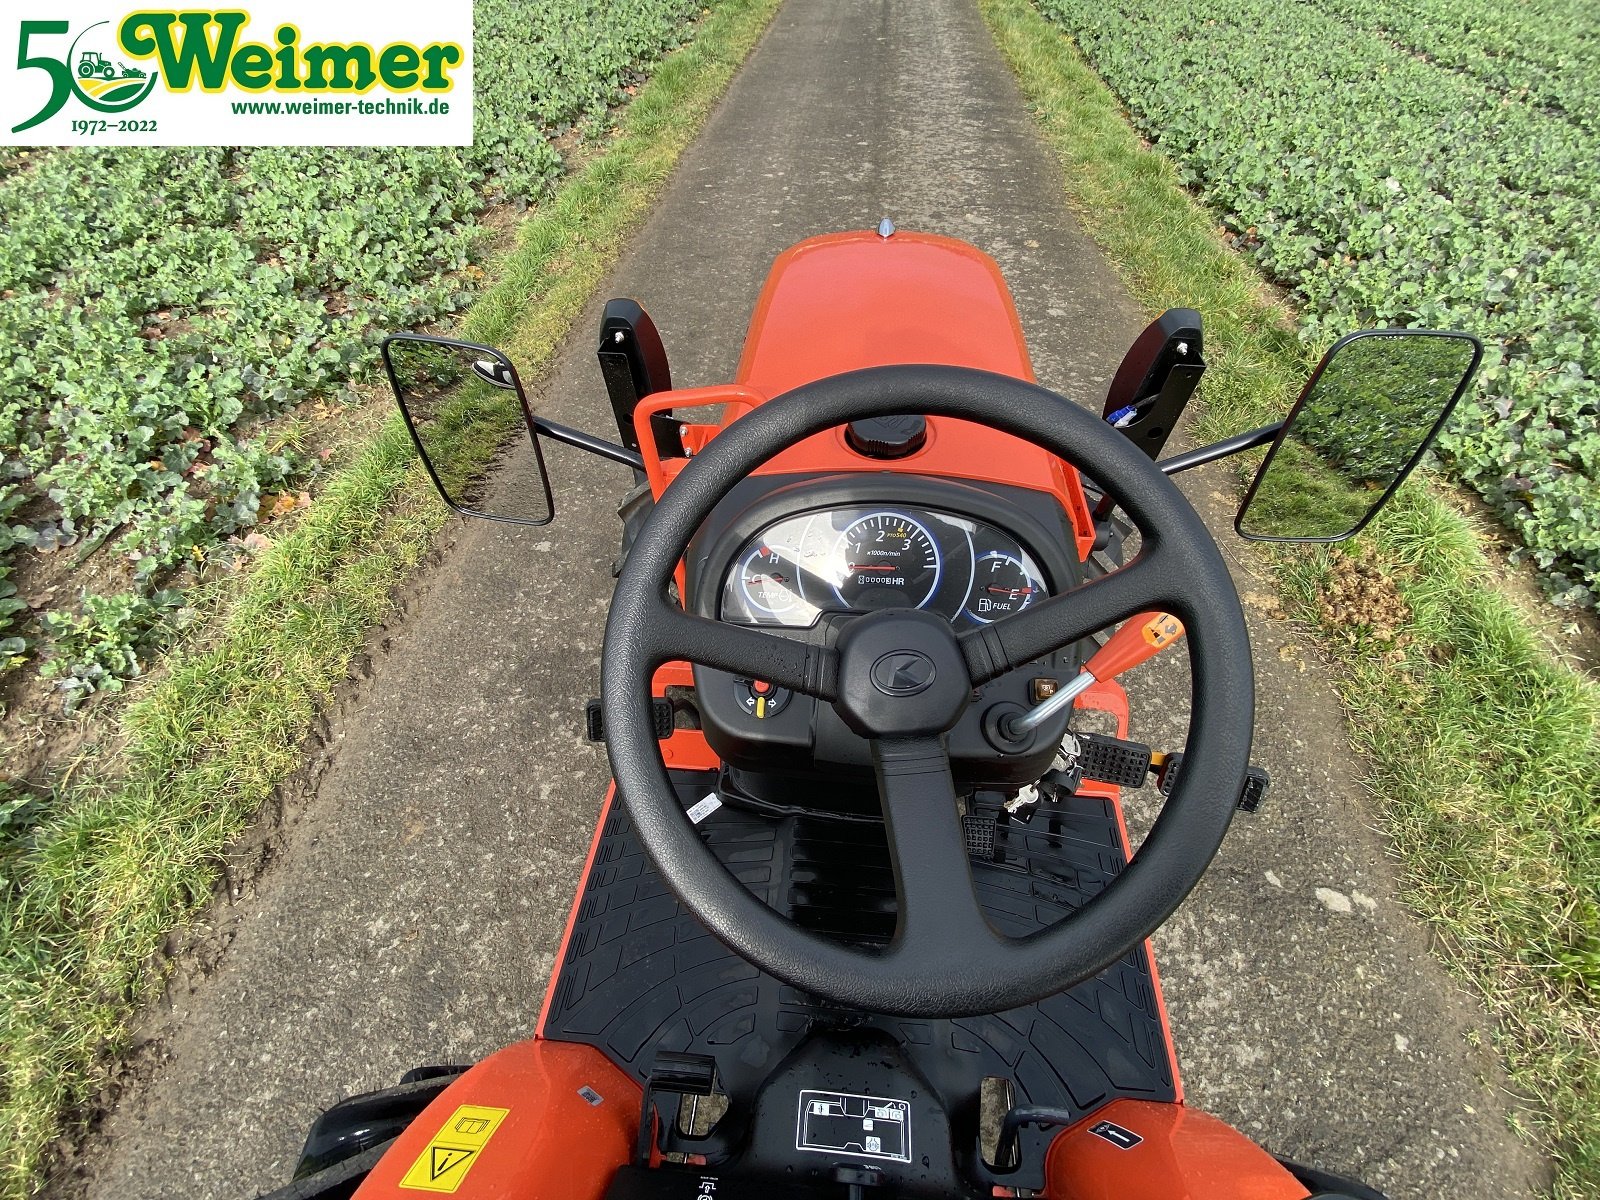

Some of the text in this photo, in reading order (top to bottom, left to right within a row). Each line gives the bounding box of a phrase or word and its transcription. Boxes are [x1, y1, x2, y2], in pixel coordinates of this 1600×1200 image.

[875, 530, 885, 542] 2
[855, 542, 861, 553] 1
[901, 538, 911, 550] 3
[769, 553, 780, 564] H
[990, 561, 1002, 572] F
[892, 577, 905, 586] HR
[1008, 588, 1020, 600] E
